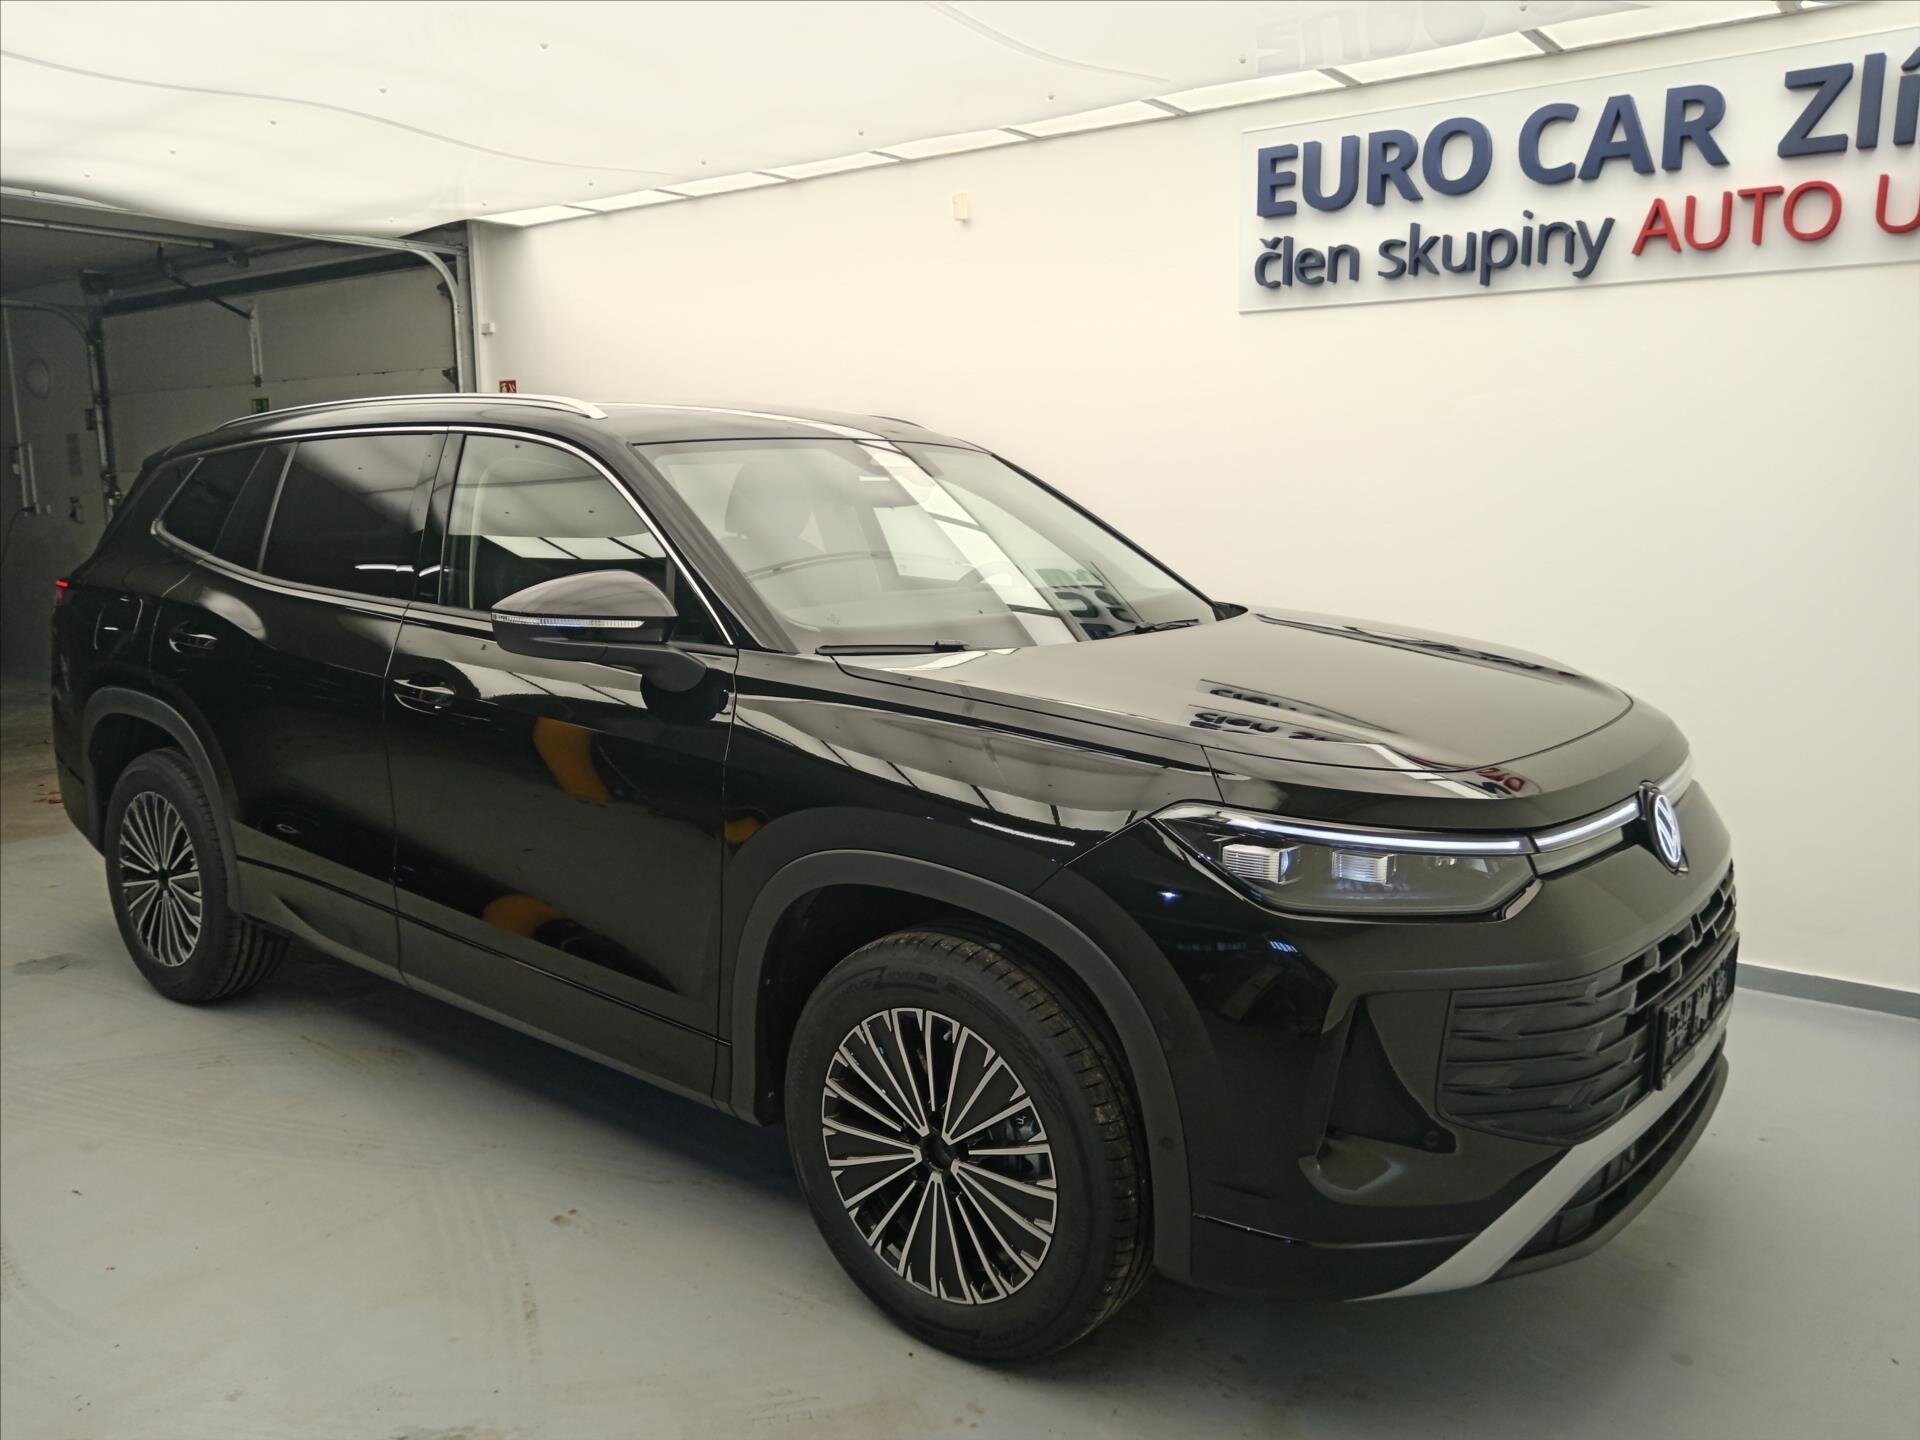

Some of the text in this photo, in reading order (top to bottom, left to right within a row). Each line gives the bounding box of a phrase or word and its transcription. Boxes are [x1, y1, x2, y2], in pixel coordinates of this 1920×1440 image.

[1258, 117, 1492, 218] EURO
[1518, 84, 1730, 185] CAR
[1254, 237, 1360, 289] člen
[1378, 210, 1615, 286] skupiny
[1632, 180, 1841, 256] AUTO
